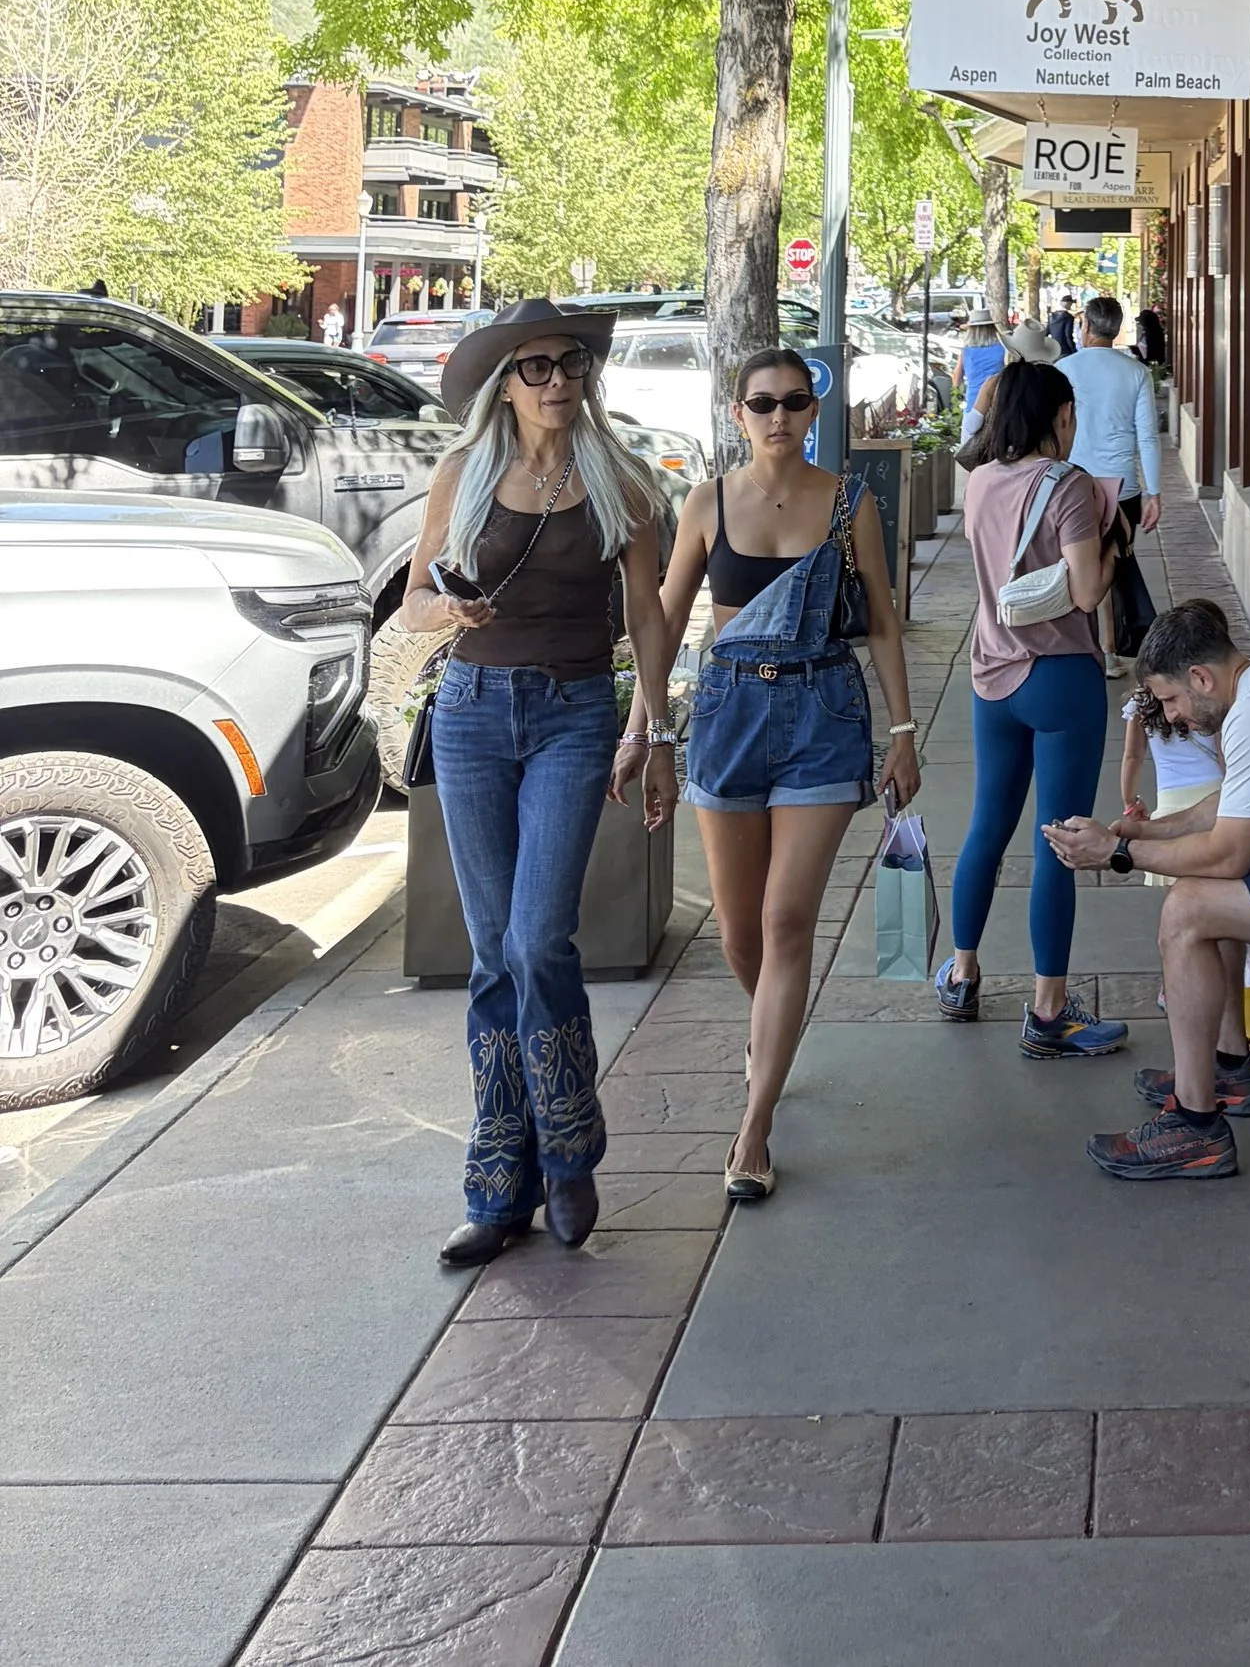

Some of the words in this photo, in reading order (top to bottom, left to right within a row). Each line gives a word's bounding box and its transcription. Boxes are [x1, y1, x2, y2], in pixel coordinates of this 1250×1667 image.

[1026, 21, 1066, 48] Joy
[1074, 23, 1130, 46] West
[1043, 47, 1112, 62] Collection
[950, 65, 997, 83] Aspen
[1035, 67, 1110, 86] Nantucket
[1135, 72, 1171, 89] Palm
[1176, 73, 1221, 90] Beach
[1034, 133, 1126, 180] ROJÈ
[1102, 181, 1131, 192] Aspen
[1063, 195, 1084, 204] REAL
[1087, 195, 1116, 204] ESTATE
[1118, 195, 1160, 204] COMPANY
[788, 248, 816, 262] STOP
